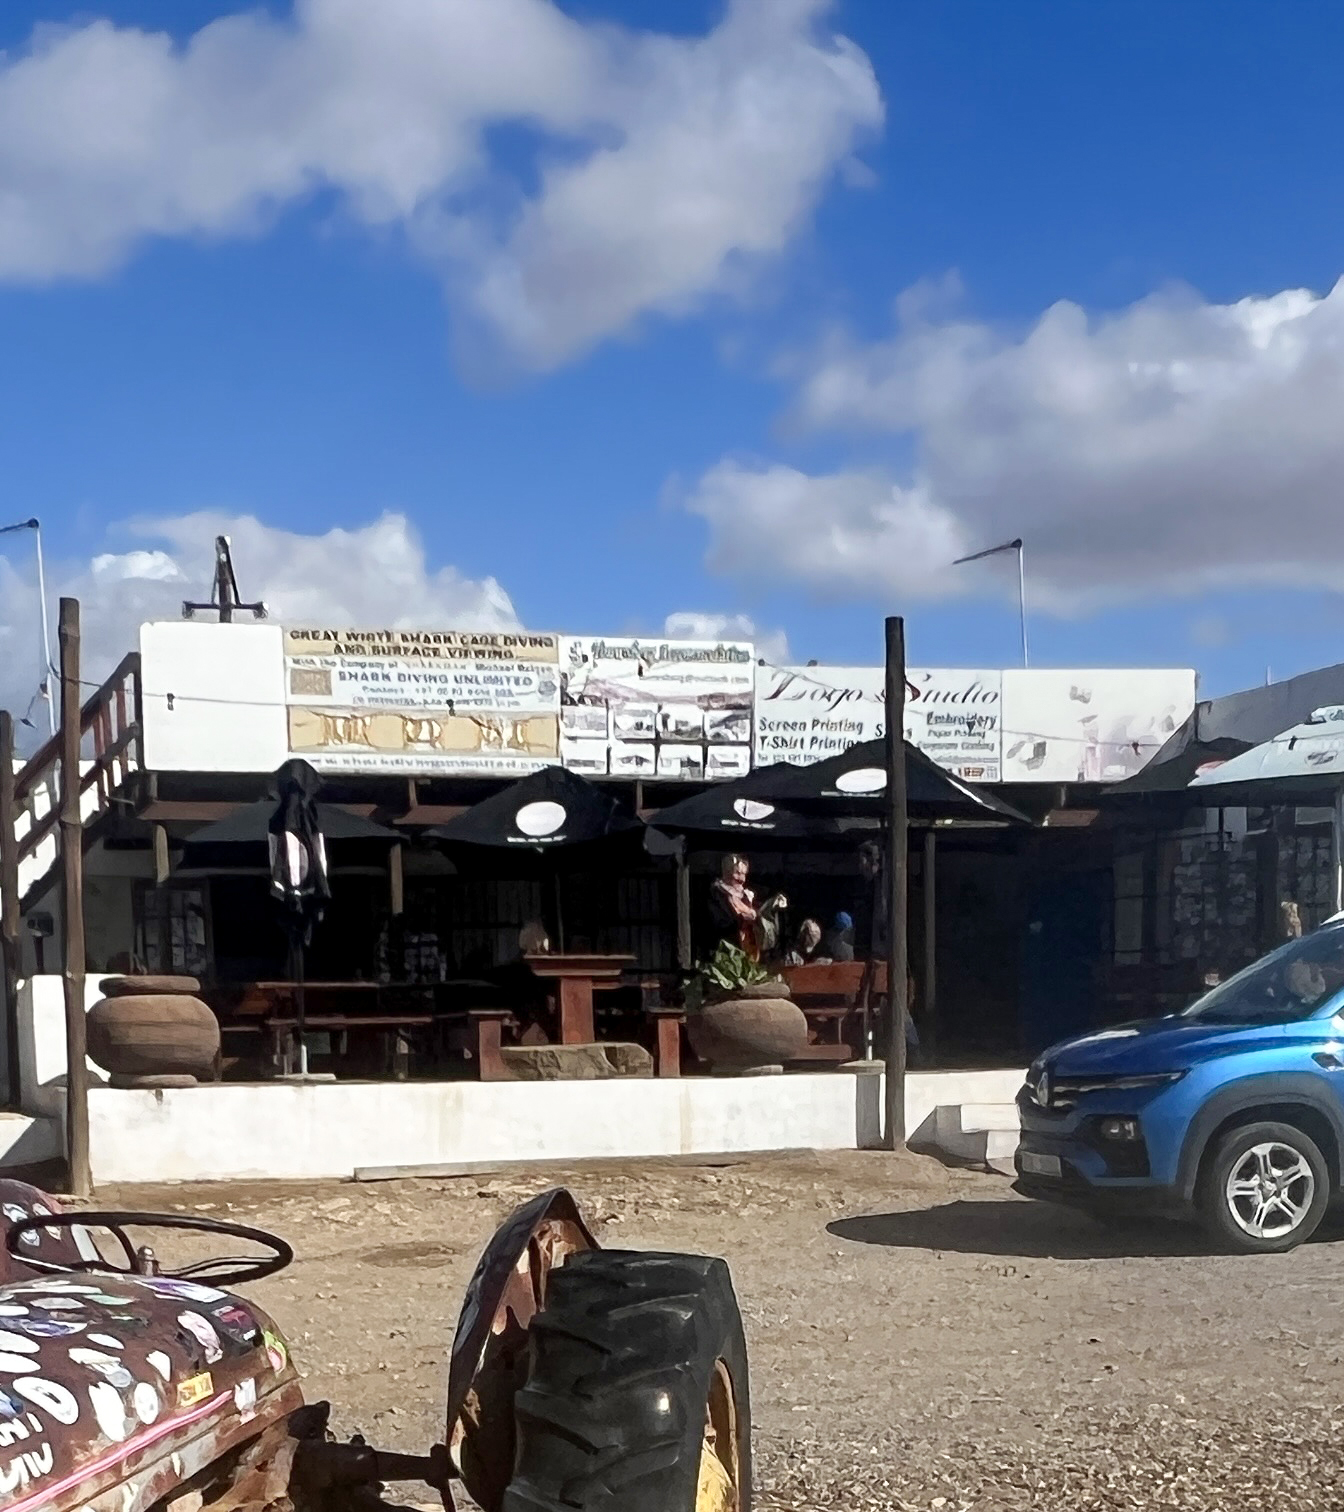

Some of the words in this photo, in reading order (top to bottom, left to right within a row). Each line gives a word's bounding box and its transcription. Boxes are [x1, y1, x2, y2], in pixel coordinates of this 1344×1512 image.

[290, 630, 338, 641] GREAT
[346, 632, 394, 643] WHITE
[401, 633, 453, 645] SHARK
[460, 635, 498, 646] CAGE
[504, 635, 554, 648] DIVING
[333, 643, 367, 656] AND
[371, 645, 440, 658] SURFACE
[448, 648, 514, 659] VIEWING
[338, 671, 392, 682] SHARK
[397, 673, 449, 684] DIVING
[454, 675, 533, 687] UNLIMITED
[763, 669, 864, 712] Logo
[759, 717, 807, 732] Screen
[811, 718, 864, 735] Printing
[926, 711, 997, 731] Embroidery
[760, 736, 805, 751] T-Shirt
[809, 737, 855, 751] Printin
